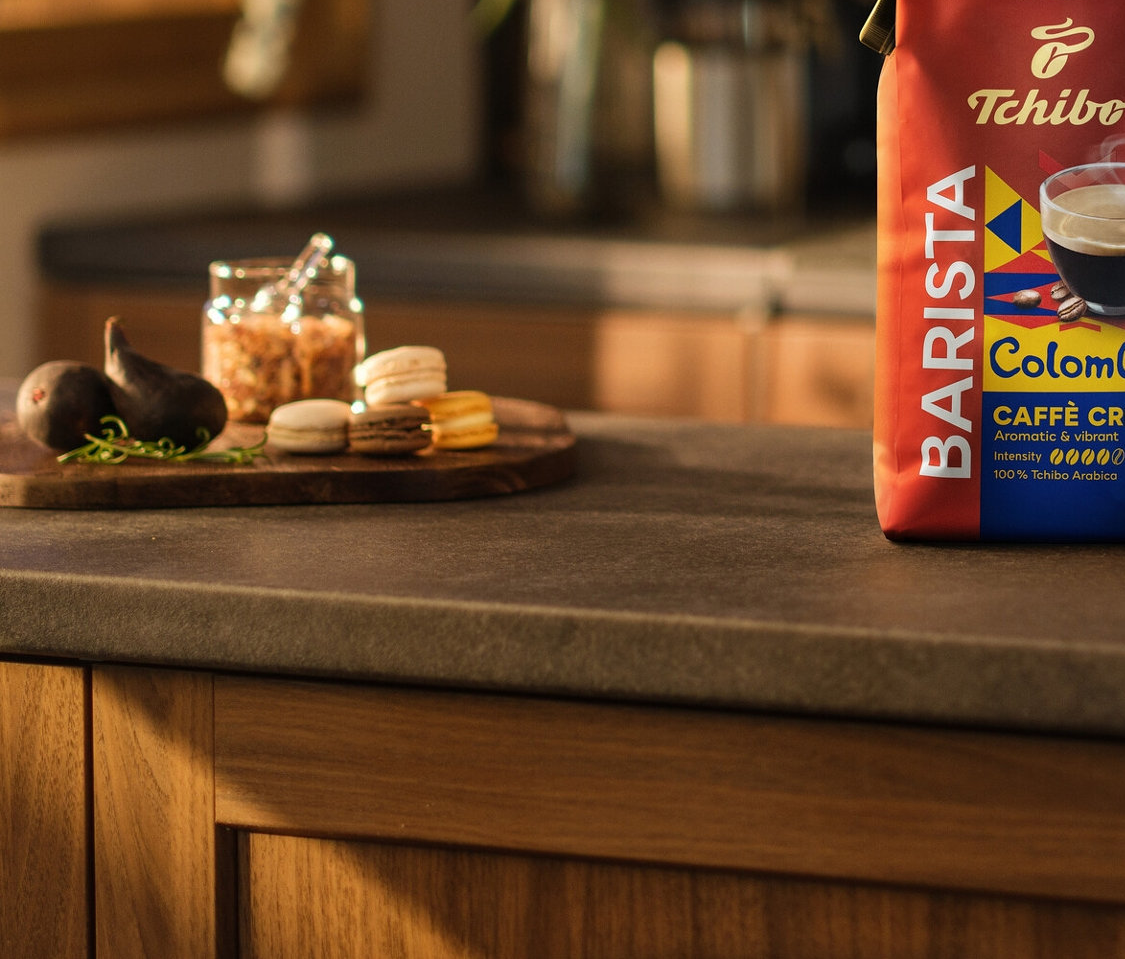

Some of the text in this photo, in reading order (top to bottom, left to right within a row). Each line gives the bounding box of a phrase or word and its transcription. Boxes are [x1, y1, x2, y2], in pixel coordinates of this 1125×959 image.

[919, 164, 976, 479] BARISTA
[992, 400, 1079, 427] CAFFÈ
[994, 429, 1119, 442] Aromatic & vibrant
[994, 450, 1042, 463] Intensity
[1031, 469, 1069, 480] Tchibo
[1072, 470, 1118, 481] Arabica
